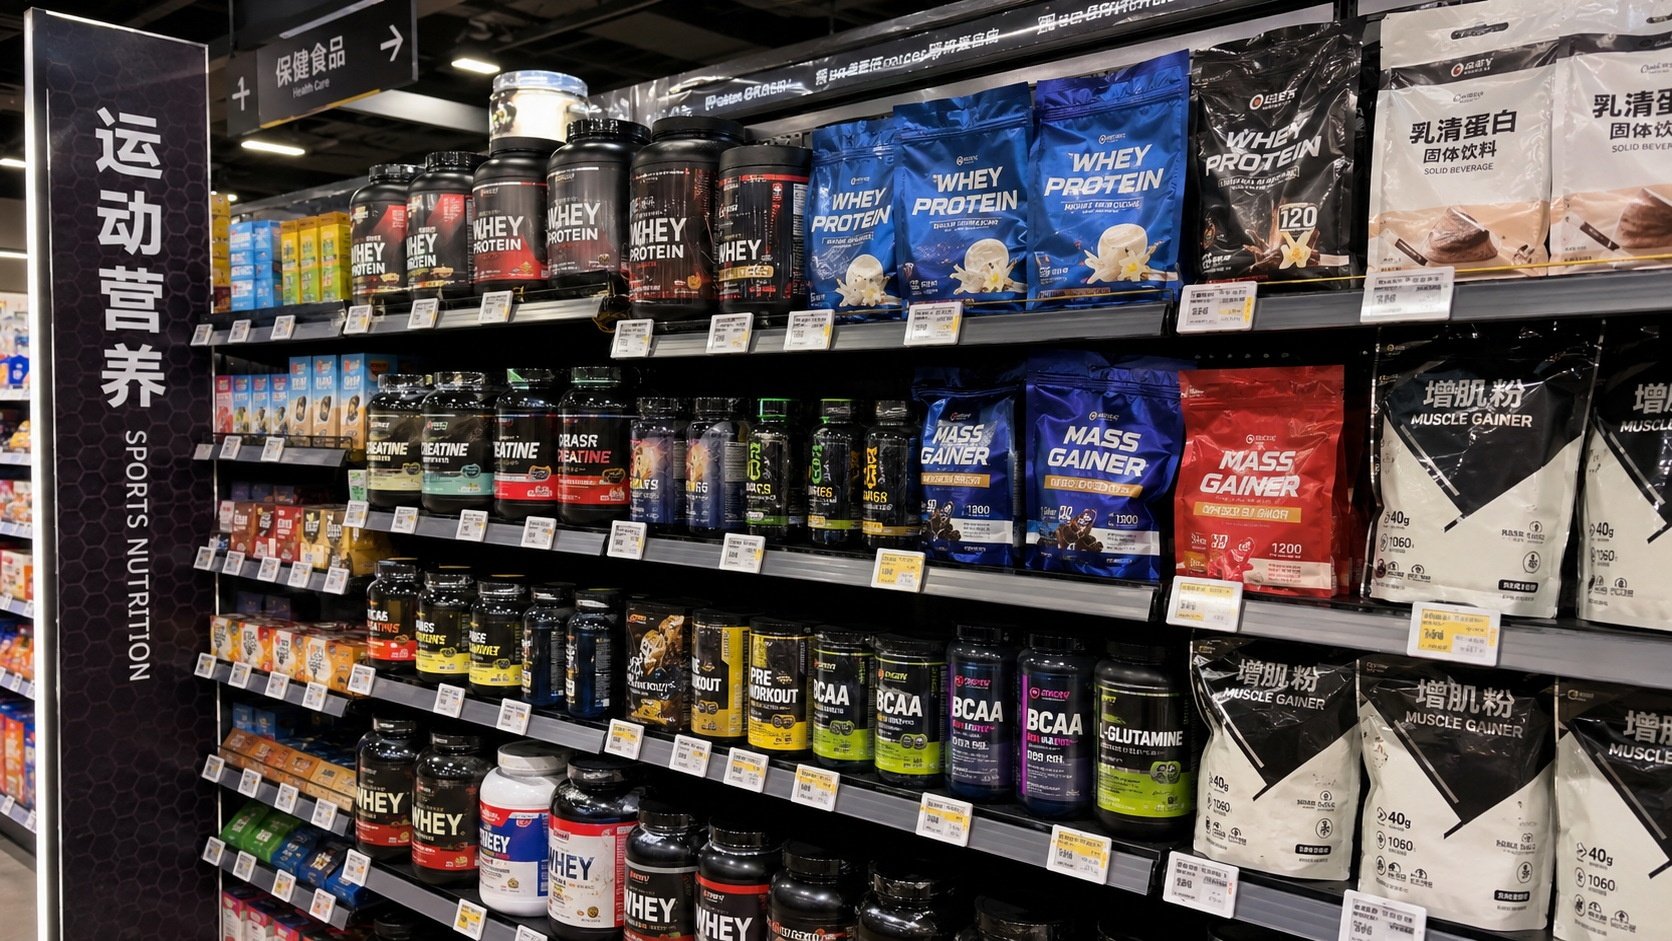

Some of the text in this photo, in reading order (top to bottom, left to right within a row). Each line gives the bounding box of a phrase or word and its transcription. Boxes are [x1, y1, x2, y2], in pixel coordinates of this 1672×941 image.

[276, 35, 345, 88] 保健食品
[292, 78, 330, 98] Health Care
[1226, 122, 1301, 150] WHEY
[1409, 109, 1518, 145] 乳清蛋白
[1071, 143, 1152, 172] WHEY
[1205, 135, 1321, 176] PROTEIN
[1423, 140, 1497, 164] 固体饮料
[1612, 143, 1639, 153] SOLID
[936, 166, 1003, 193] WHEY
[1044, 167, 1164, 197] PROTEIN
[1424, 162, 1494, 176] SOLID BEVERAGE
[831, 187, 887, 211] WHEY
[911, 189, 1018, 216] PROTEIN
[473, 216, 524, 240] WHEY
[548, 202, 601, 230] WHEY
[811, 205, 892, 233] PROTEIN
[1279, 207, 1317, 229] 120
[547, 228, 598, 244] PROTEIN
[630, 218, 687, 246] WHEY
[95, 106, 166, 408] 运动营养
[473, 238, 522, 254] PROTEIN
[630, 244, 684, 262] PROTEIN
[718, 239, 762, 264] WHEY
[1423, 378, 1526, 408] 增肌粉
[1633, 382, 1672, 414] 增
[1410, 412, 1533, 428] MUSCLE GAINER
[932, 424, 985, 445] MASS
[1063, 426, 1142, 452] MASS
[920, 446, 990, 466] GAINER
[1048, 448, 1147, 477] GAINER
[1218, 450, 1297, 472] MASS
[1200, 472, 1301, 498] GAINER
[124, 430, 150, 681] SPORTS NUTRITION
[1272, 542, 1302, 554] 1200
[750, 666, 772, 686] PRE
[1235, 658, 1319, 692] 增肌粉
[814, 678, 850, 706] BCAA
[876, 690, 923, 717] BCAA
[1224, 687, 1326, 711] MUSCLE GAINER
[1414, 678, 1515, 719] 增肌粉
[952, 696, 1004, 722] BCAA
[1026, 708, 1084, 736] BCAA
[1100, 722, 1184, 747] L-GLUTAMINE
[1405, 710, 1524, 739] MUSCLE GAINER
[412, 805, 463, 836] WHEY
[1388, 812, 1411, 830] 40g
[1388, 836, 1413, 852] 1060
[1588, 847, 1614, 866] 40g
[1588, 874, 1616, 892] 1060
[624, 888, 677, 924] WHEY
[695, 902, 754, 941] WHEY
